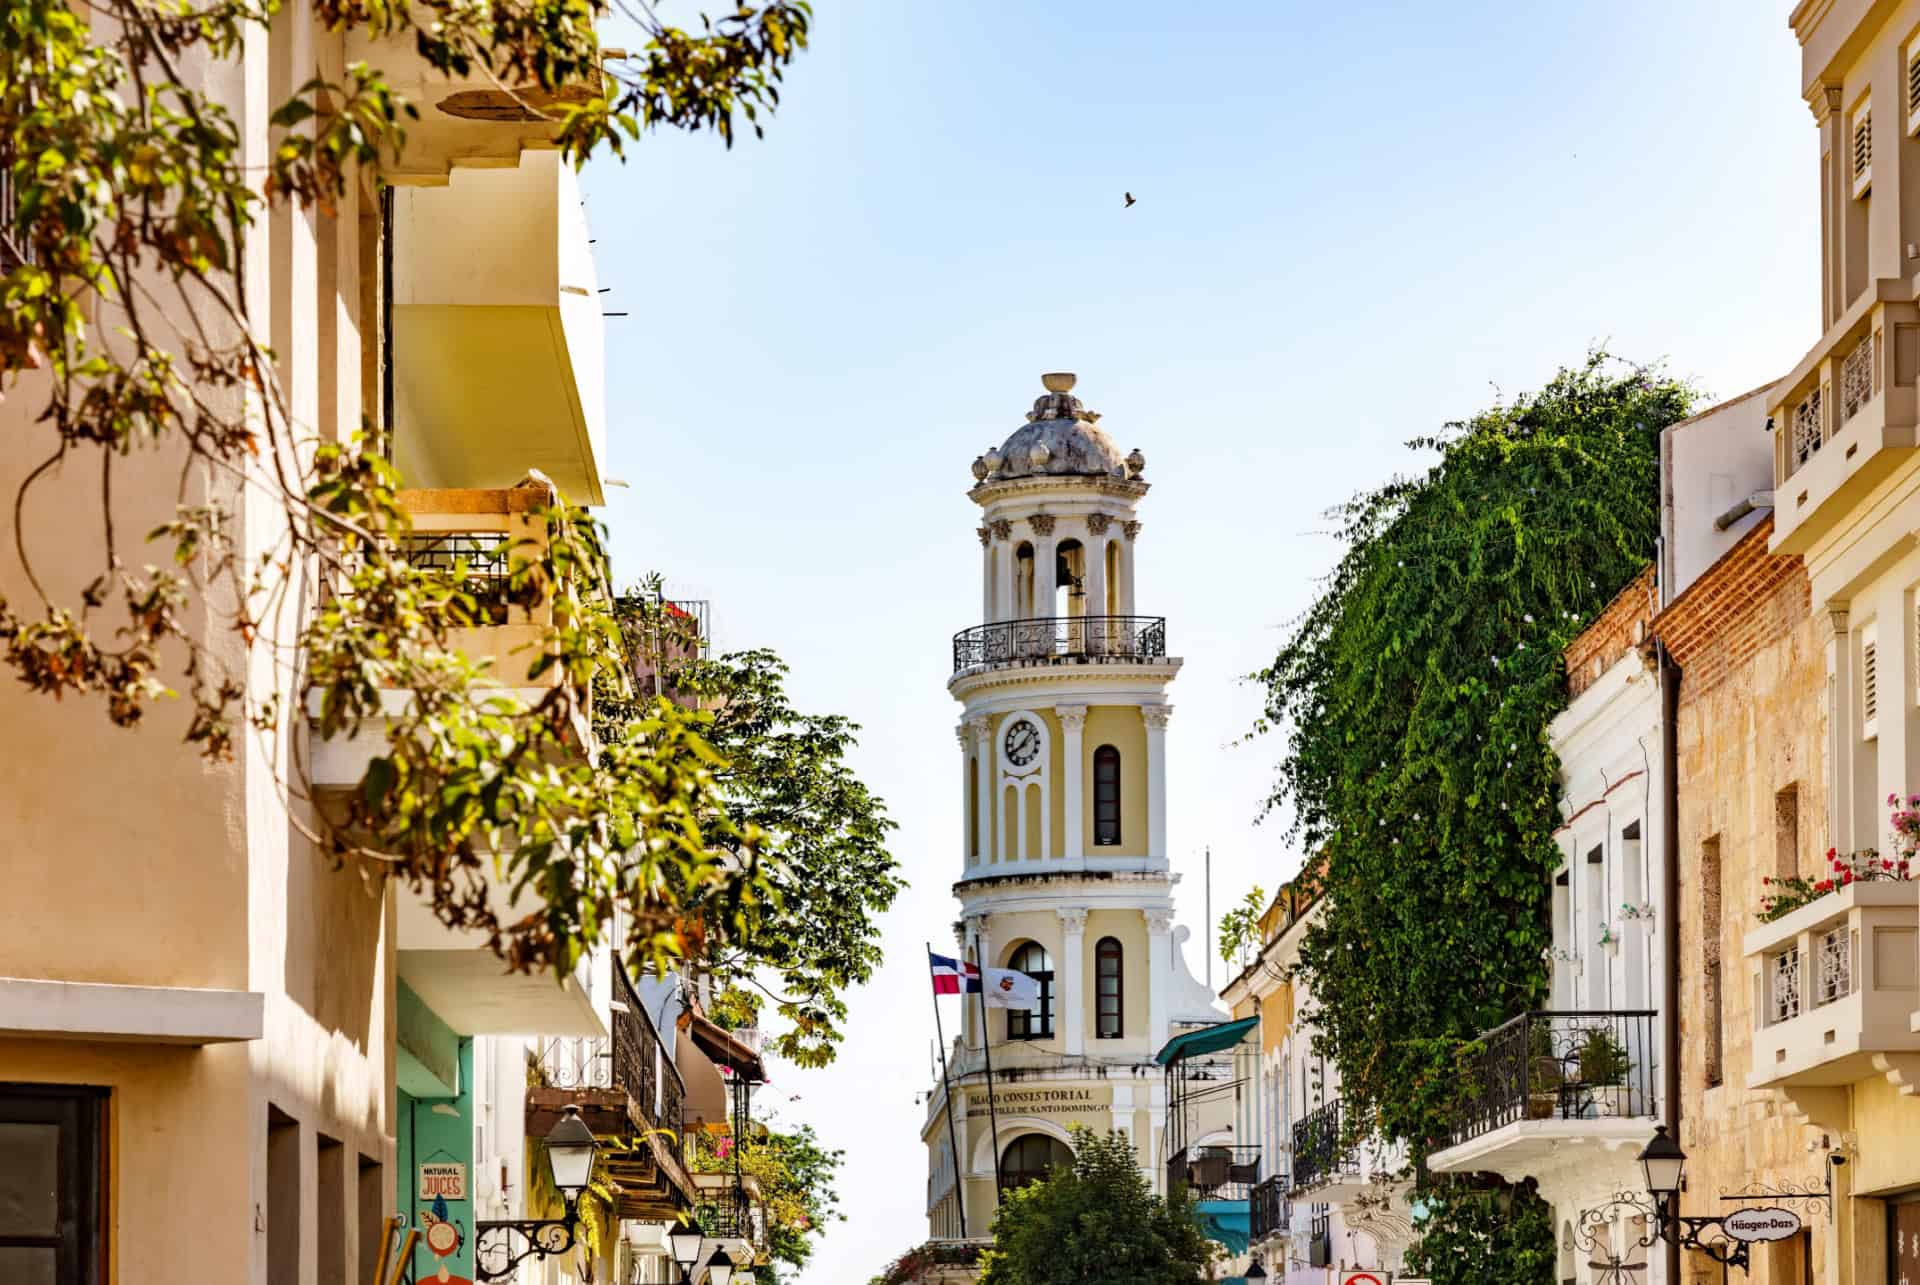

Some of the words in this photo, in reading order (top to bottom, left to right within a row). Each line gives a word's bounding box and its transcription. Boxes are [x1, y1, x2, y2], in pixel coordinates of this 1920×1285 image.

[1003, 1089, 1092, 1102] CONSISTORIAL
[422, 1176, 461, 1195] JUICES
[1731, 1219, 1793, 1231] Häagen-Dazs
